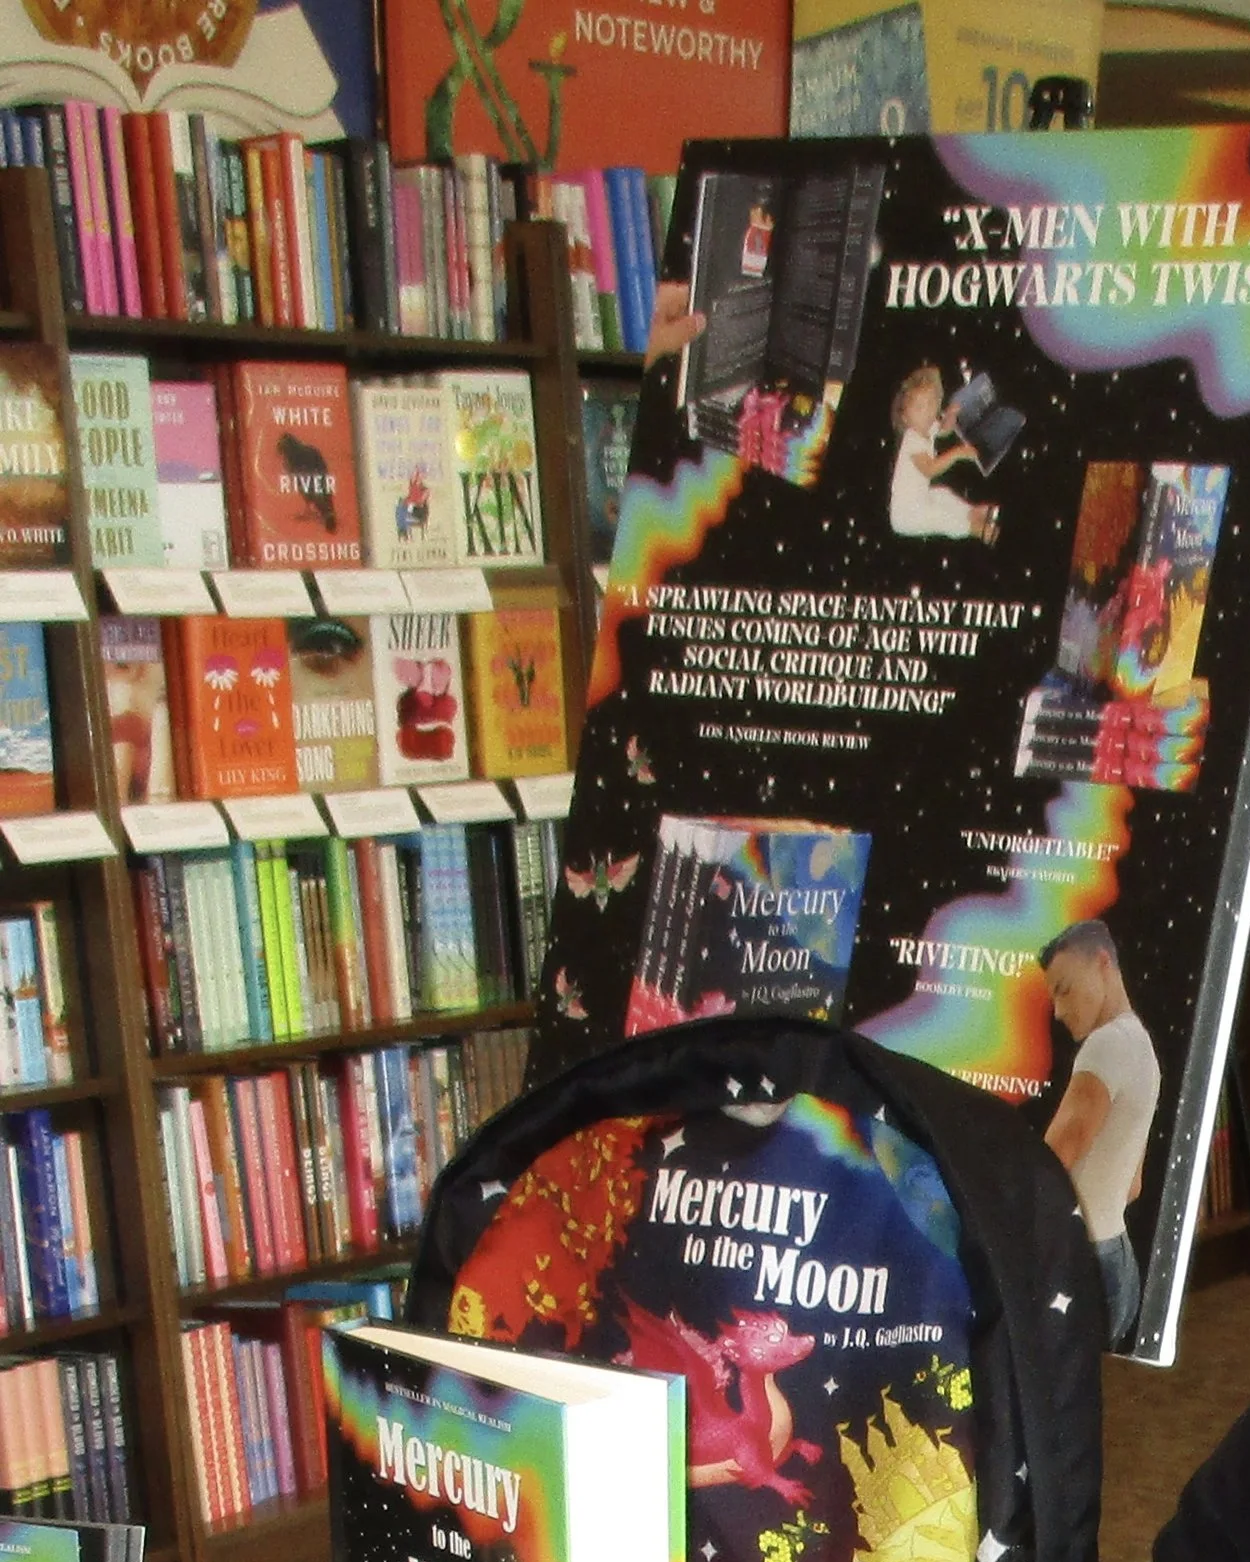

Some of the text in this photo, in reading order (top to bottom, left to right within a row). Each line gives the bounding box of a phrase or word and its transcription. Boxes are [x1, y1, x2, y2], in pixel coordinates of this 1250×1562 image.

[99, 31, 195, 72] BOOKS
[574, 11, 763, 71] NOTEWORTHY
[943, 202, 1104, 251] "X-MEN
[1117, 203, 1241, 248] WITH
[886, 260, 1139, 309] HOGWARTS
[272, 407, 333, 427] WHITE
[280, 475, 337, 494] RIVER
[457, 471, 536, 556] KIN
[21, 528, 65, 543] WHITE
[263, 543, 361, 561] CROSSING
[646, 585, 773, 614] SPRAWLING
[963, 602, 1025, 628] THAT
[388, 614, 450, 650] SHEER
[647, 614, 726, 640] FUSUES
[918, 629, 979, 656] WITH
[684, 645, 928, 683] SOCIAL CRITIQUE AND
[650, 670, 750, 700] RADIANT
[699, 723, 870, 749] LOS ANGELES BOOK REVIEW
[218, 766, 288, 784] LILY KING
[961, 830, 1119, 861] "UNFORGETTABLE!"
[731, 881, 845, 924] Mercury
[741, 940, 811, 974] Moon
[889, 938, 1034, 978] "RIVETING!"
[649, 1168, 828, 1246] Mercury
[683, 1233, 889, 1315] to the Moon
[842, 1327, 870, 1349] J.Q.
[875, 1323, 943, 1348] Gagliastro
[376, 1415, 522, 1533] Mercury
[432, 1524, 472, 1560] to the
